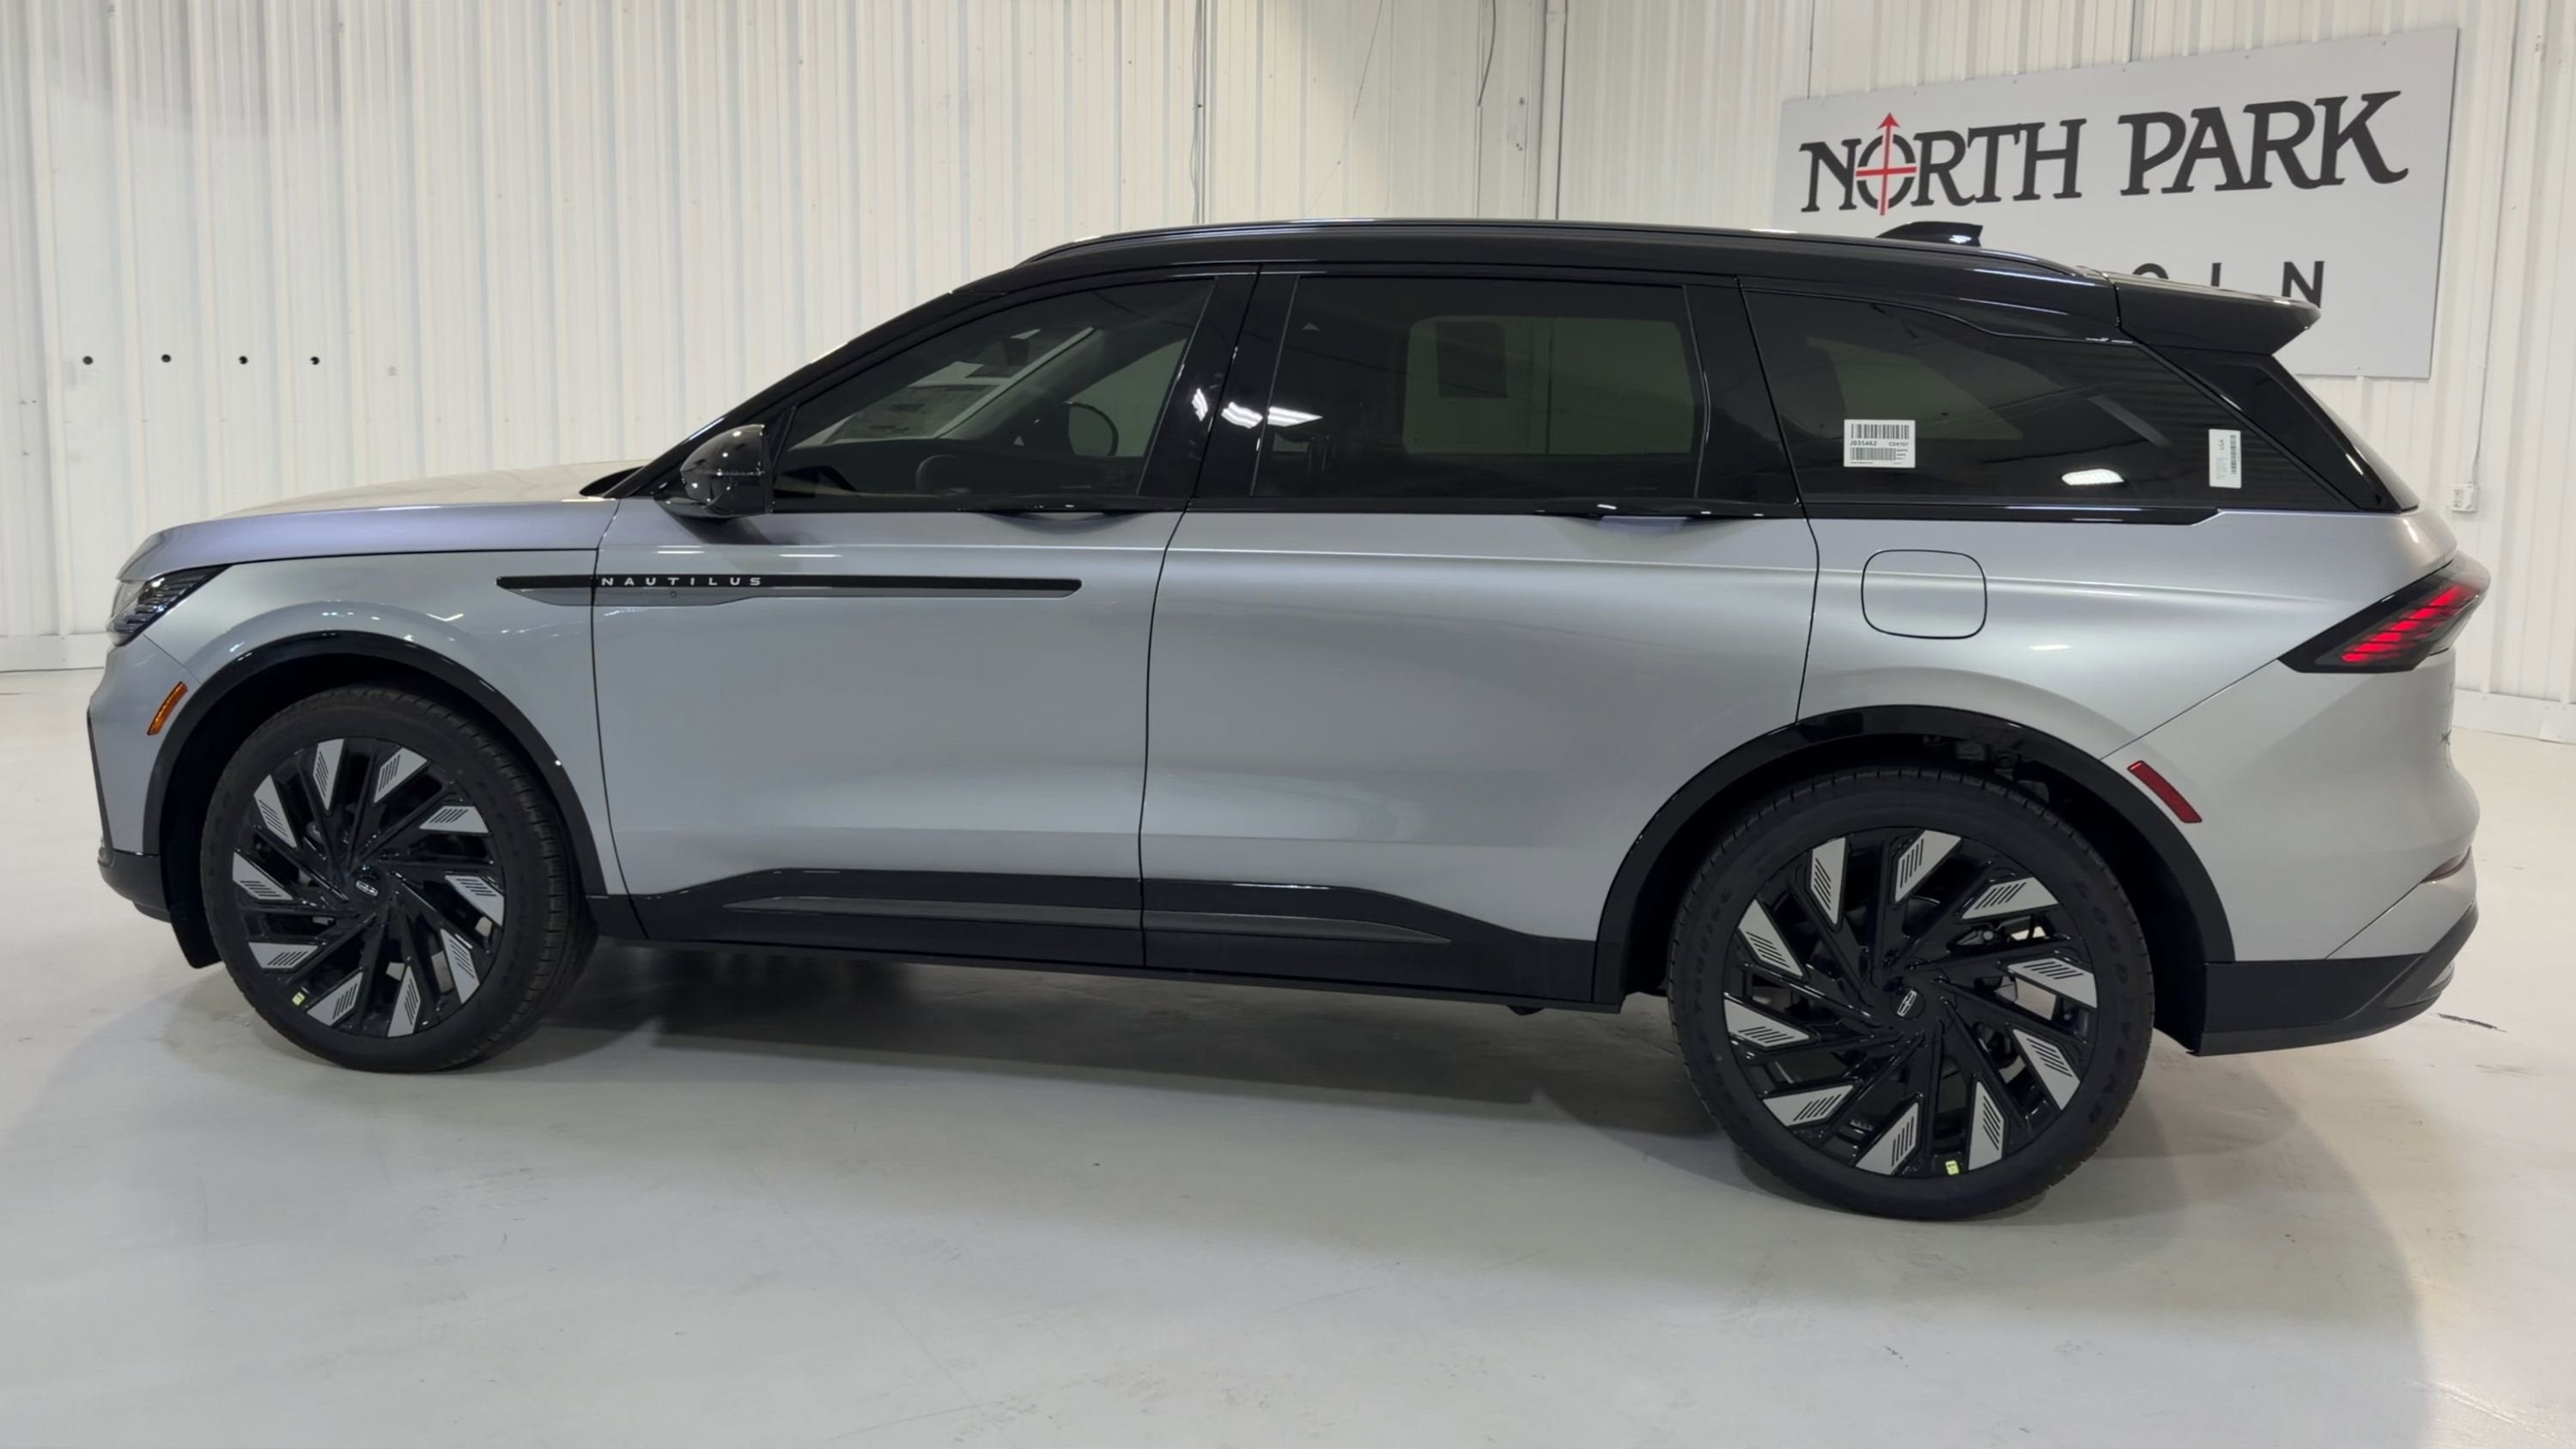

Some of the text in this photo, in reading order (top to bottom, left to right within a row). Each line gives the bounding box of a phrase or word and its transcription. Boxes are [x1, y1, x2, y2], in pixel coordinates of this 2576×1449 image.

[1799, 90, 2409, 213] NORTH PARK
[602, 577, 762, 586] NAUTILUS
